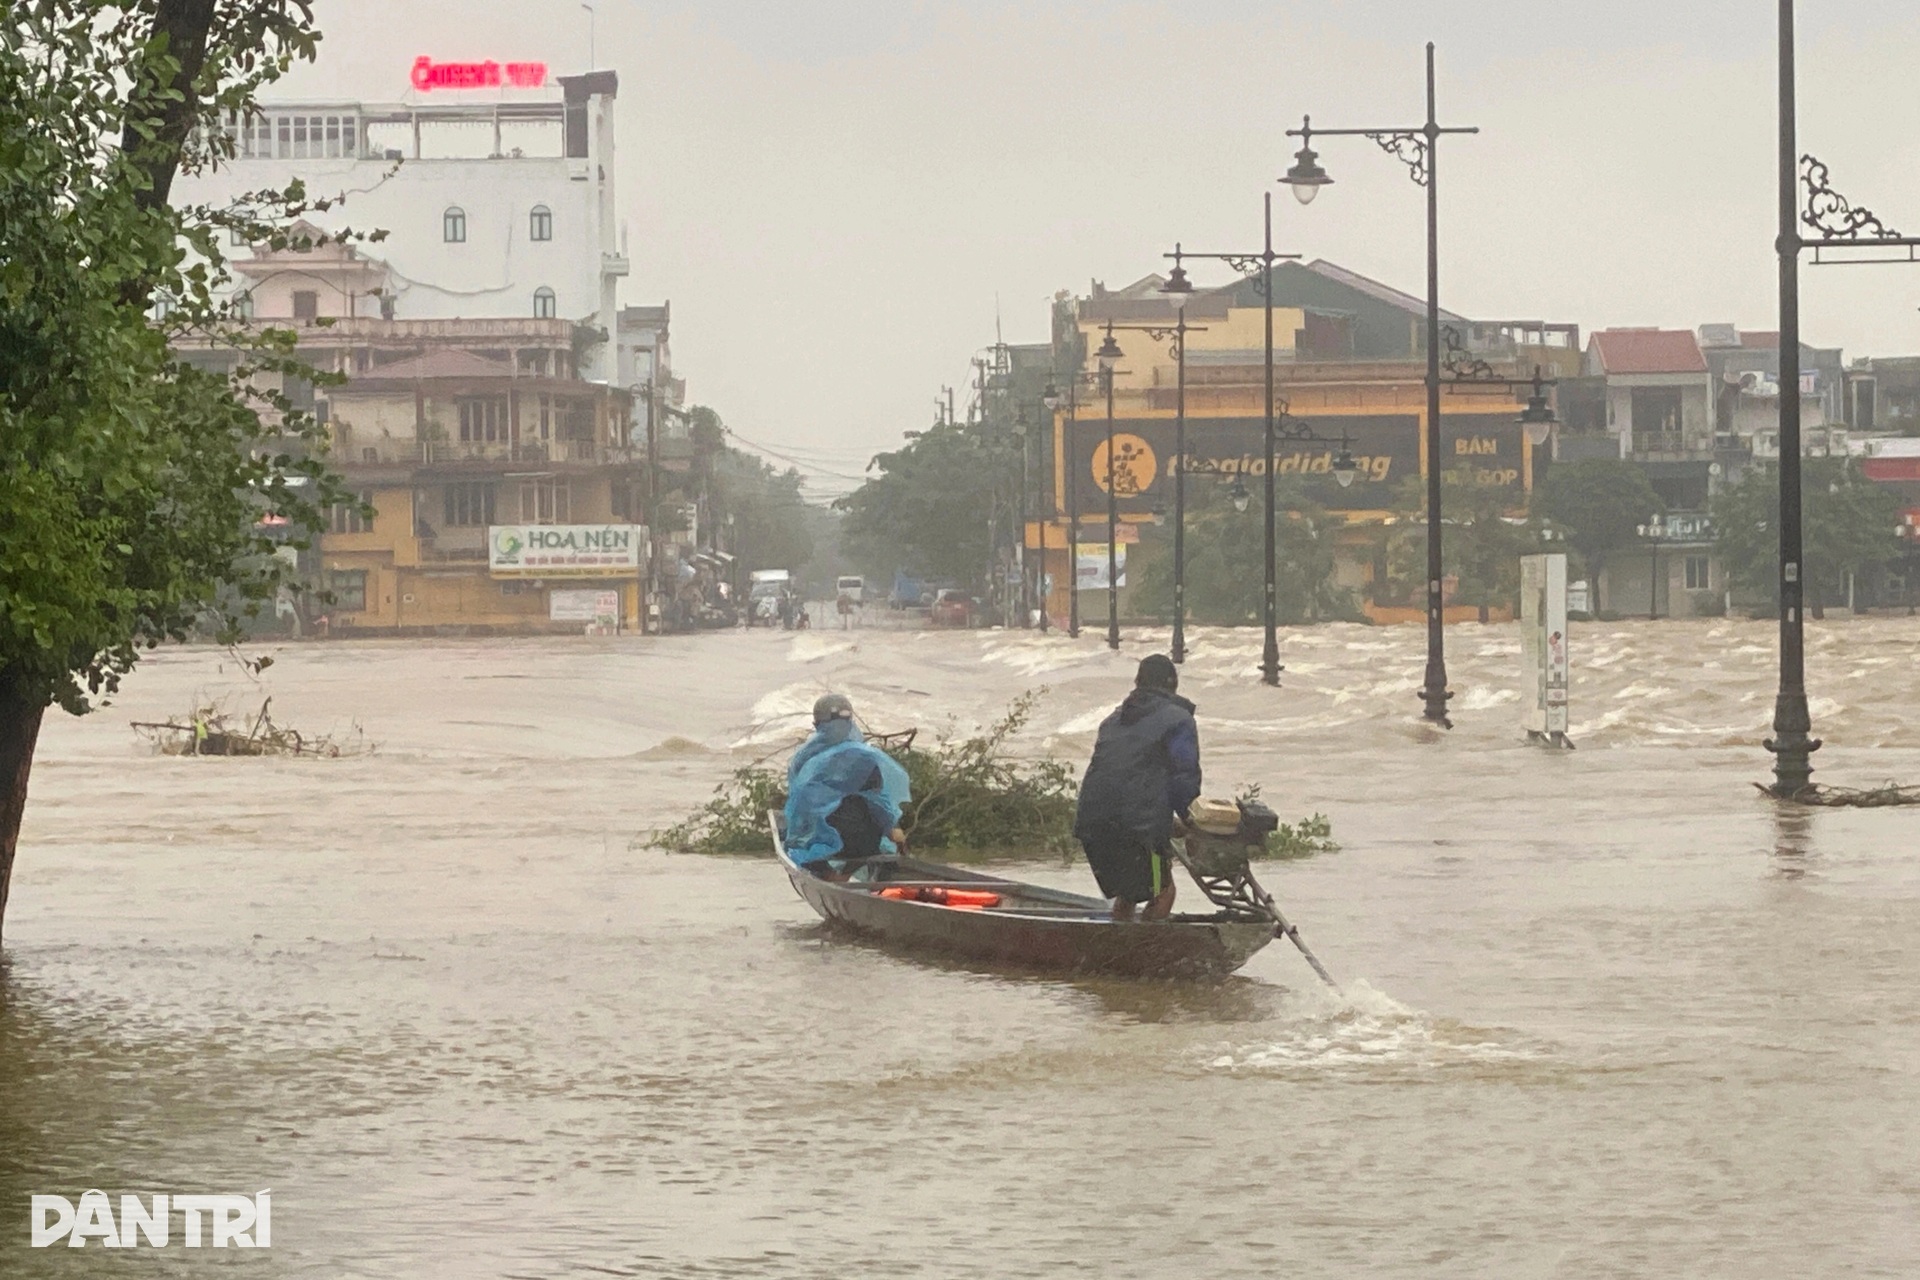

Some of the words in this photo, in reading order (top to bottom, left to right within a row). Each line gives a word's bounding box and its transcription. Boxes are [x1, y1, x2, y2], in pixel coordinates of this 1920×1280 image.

[1455, 435, 1498, 455] BÁN
[1166, 450, 1392, 484] tgioididng
[528, 530, 579, 549] HOA
